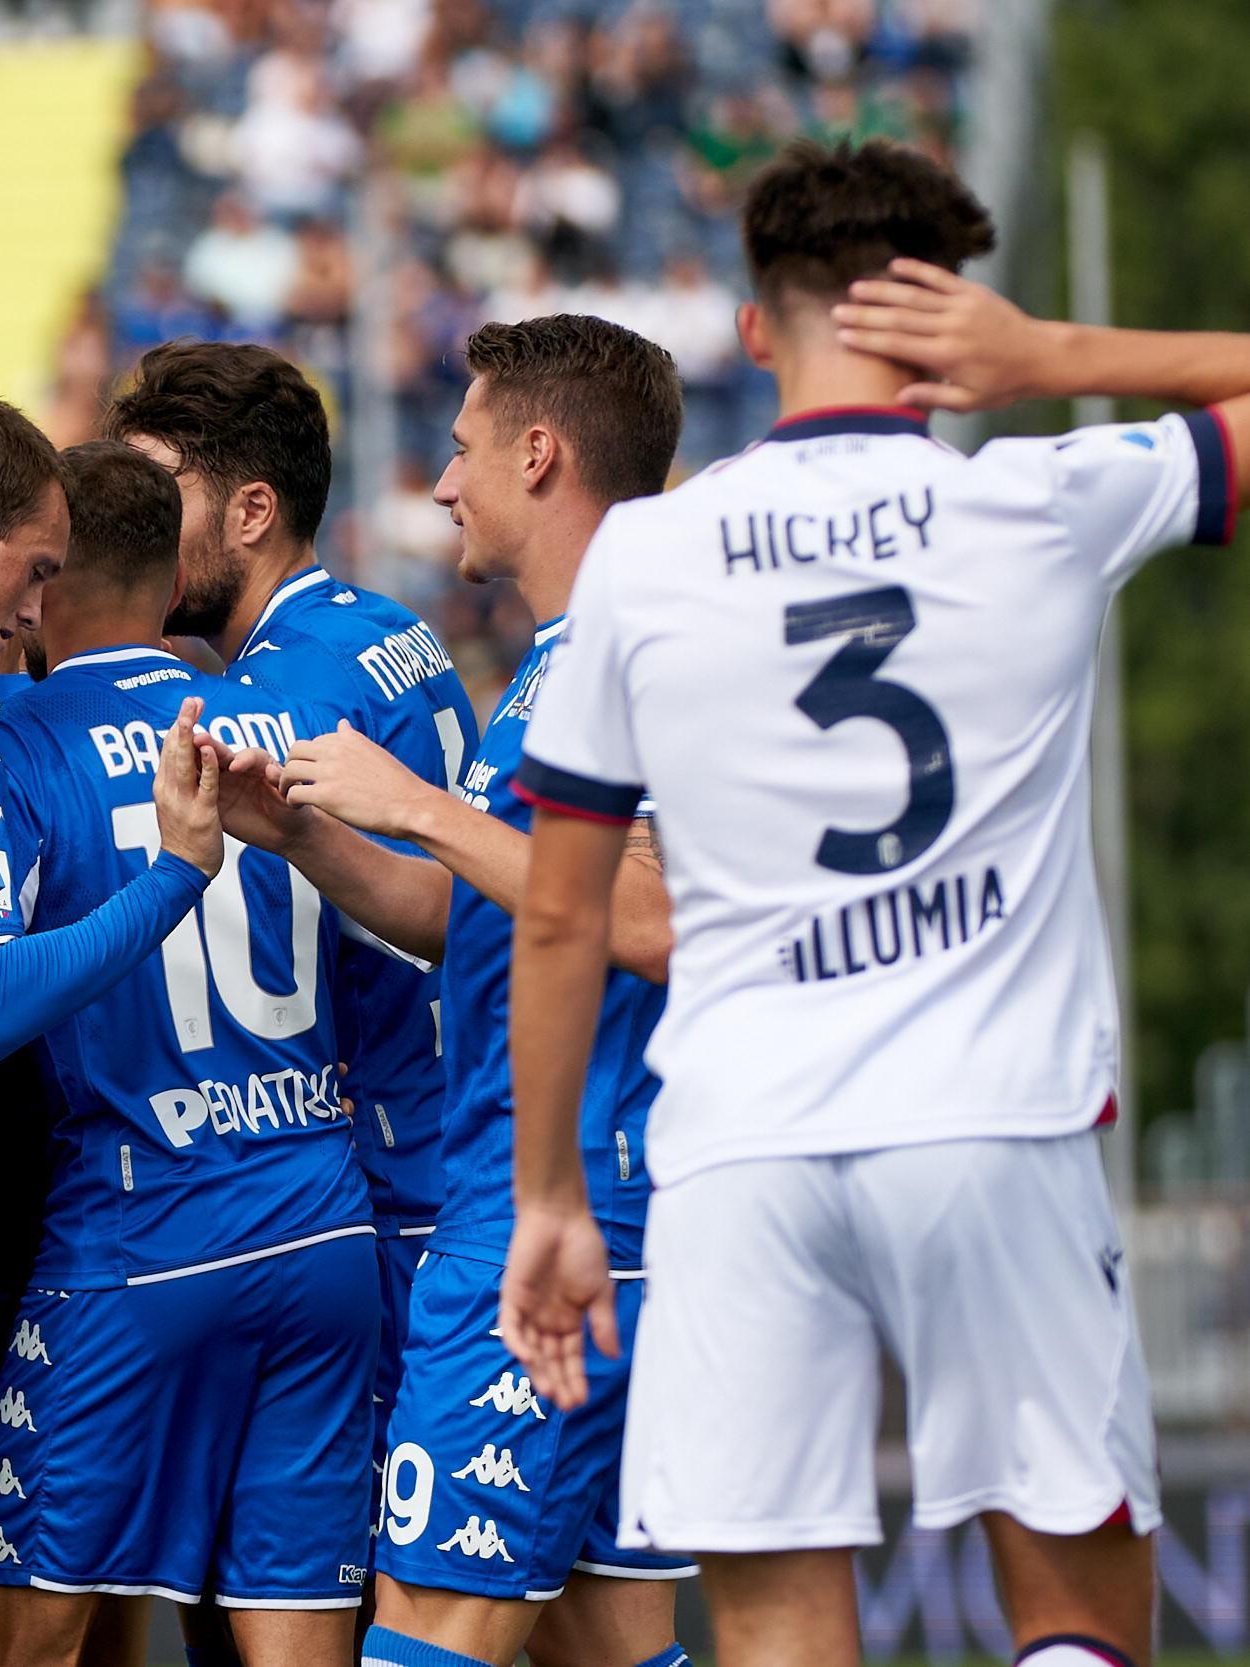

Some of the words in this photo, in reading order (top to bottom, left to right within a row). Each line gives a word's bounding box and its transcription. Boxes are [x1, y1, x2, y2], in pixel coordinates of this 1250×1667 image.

[719, 485, 936, 577] HICKEY
[88, 711, 299, 779] BAAMI
[784, 585, 957, 876] 3
[111, 801, 322, 1054] 10
[790, 865, 1008, 984] ILLUMIA
[379, 1441, 435, 1546] 9
